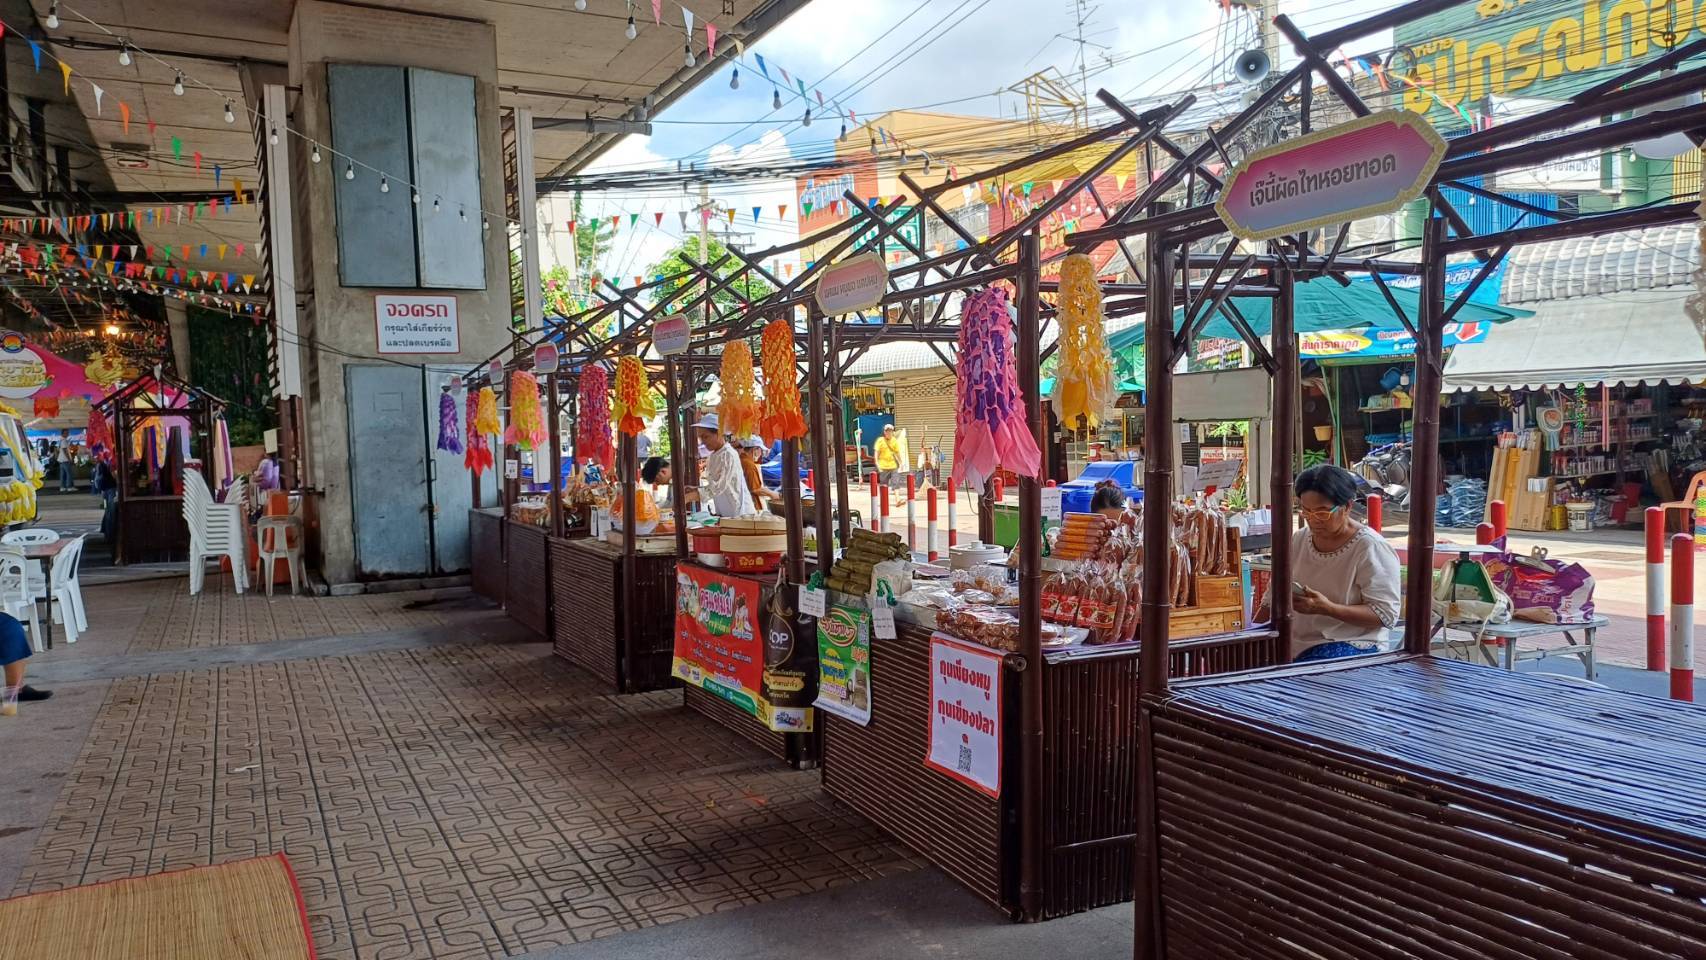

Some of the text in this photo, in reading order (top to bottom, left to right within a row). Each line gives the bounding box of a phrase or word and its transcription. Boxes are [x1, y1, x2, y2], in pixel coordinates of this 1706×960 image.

[386, 303, 448, 317] จอดรถ
[940, 659, 991, 701] กุนเชียงหมู
[938, 699, 995, 737] กุนเชียงปลา
